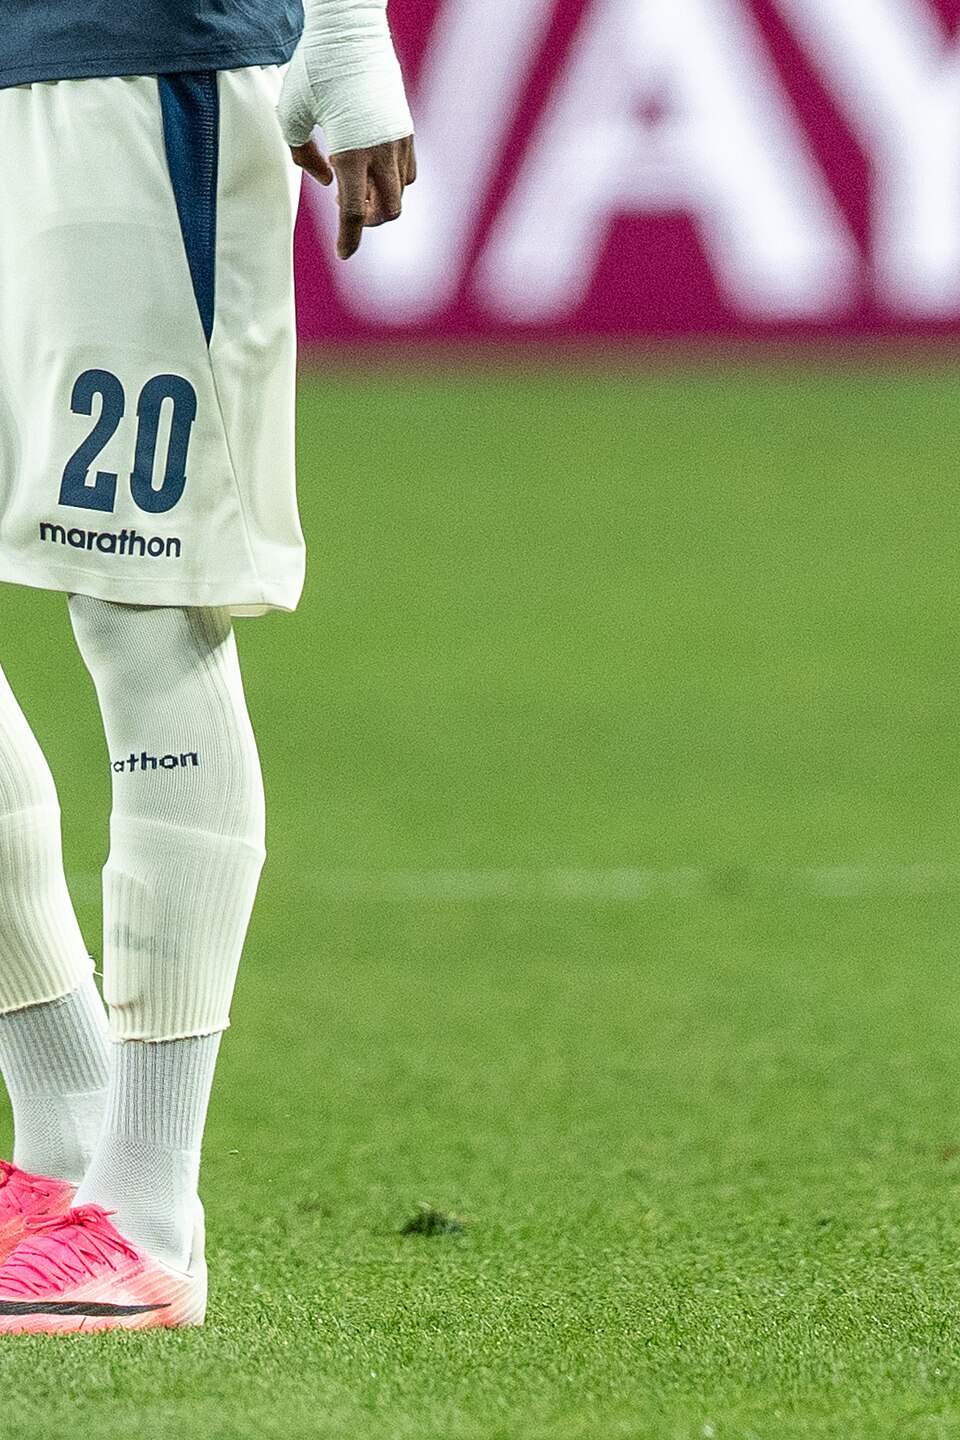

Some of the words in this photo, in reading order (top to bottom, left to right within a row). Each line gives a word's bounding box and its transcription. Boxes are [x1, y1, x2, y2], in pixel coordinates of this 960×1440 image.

[58, 369, 197, 513] 20
[39, 522, 181, 558] marathon
[110, 751, 199, 773] athon
